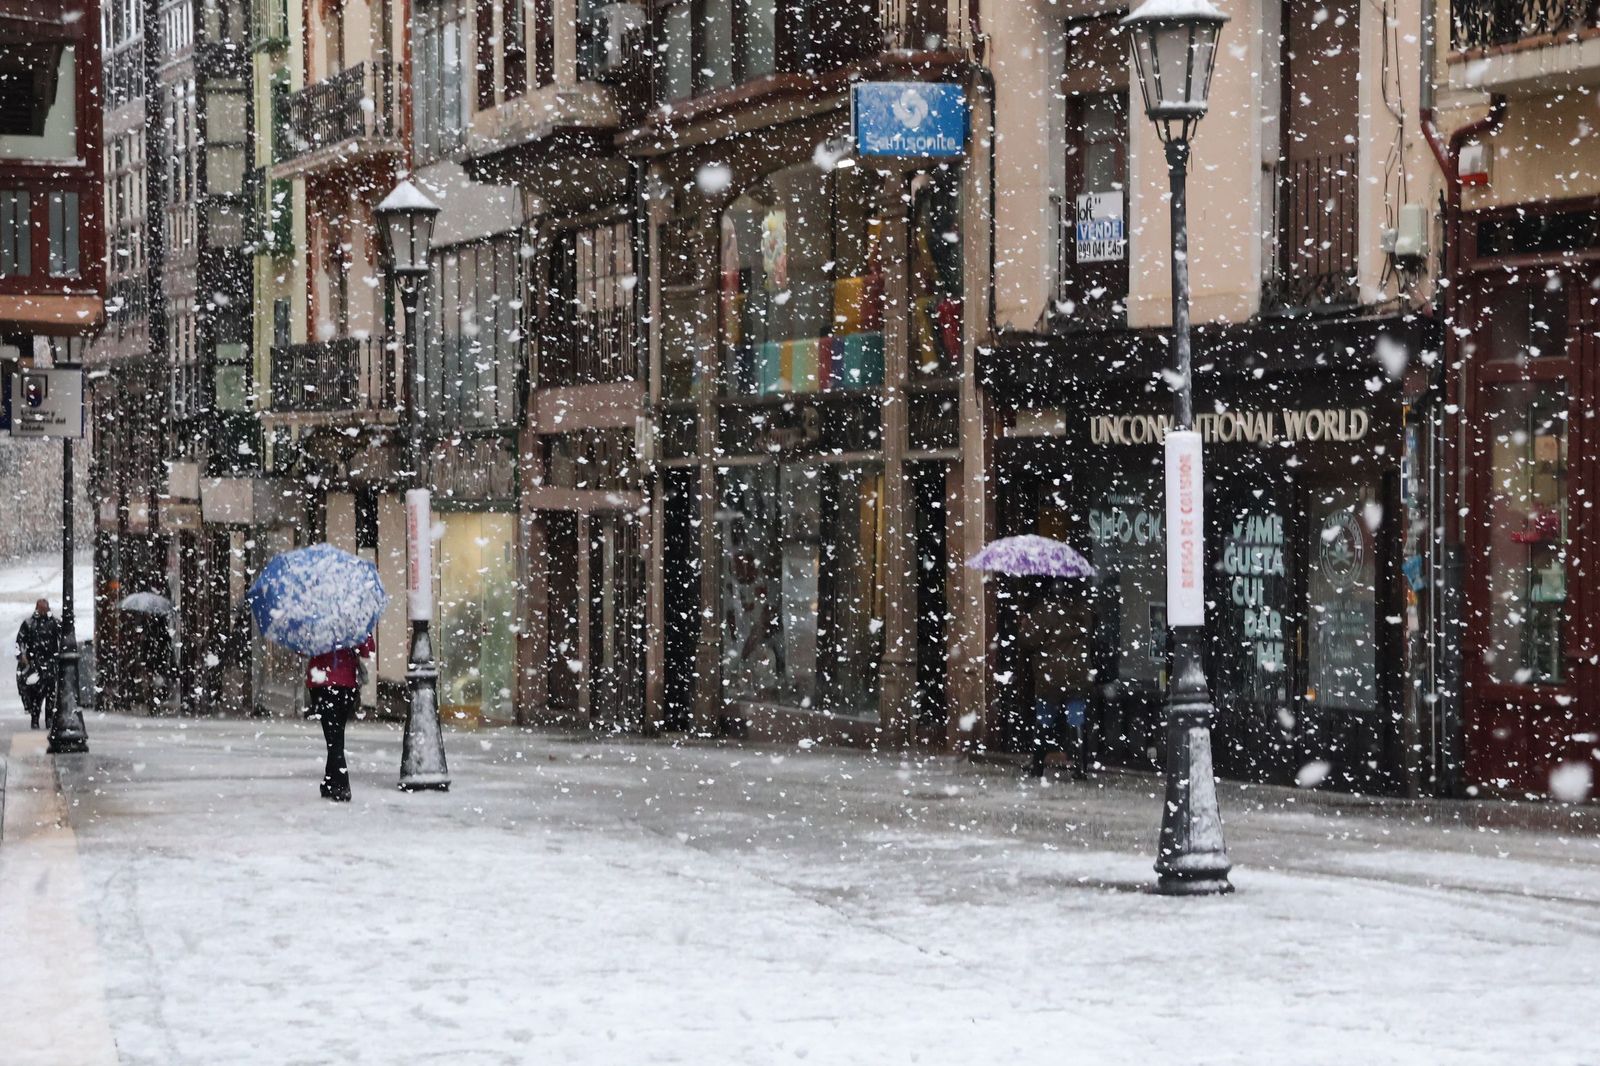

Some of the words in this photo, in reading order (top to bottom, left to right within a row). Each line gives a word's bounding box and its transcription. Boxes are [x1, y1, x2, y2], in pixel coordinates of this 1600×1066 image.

[866, 134, 956, 151] Samsonite
[1080, 220, 1120, 240] VENDE
[1092, 241, 1105, 257] 041
[1090, 411, 1277, 445] UNCONVNTIONAL
[1283, 409, 1369, 441] WORLD
[1223, 546, 1285, 577] GUSTA
[1232, 577, 1264, 606] CUI
[1244, 609, 1283, 639] DAR
